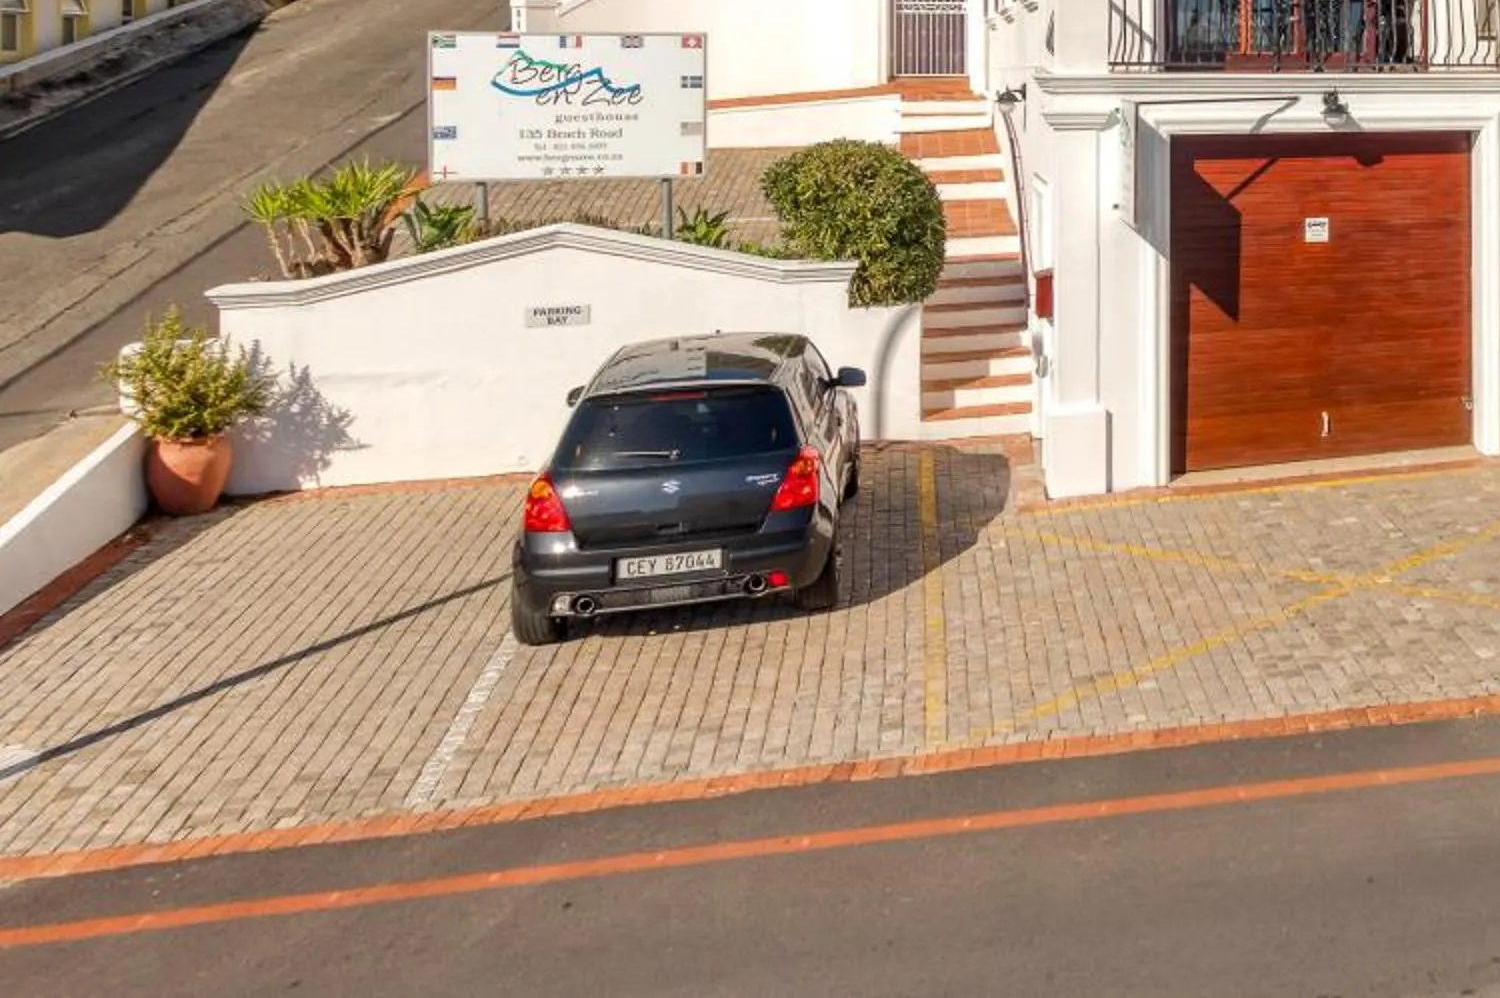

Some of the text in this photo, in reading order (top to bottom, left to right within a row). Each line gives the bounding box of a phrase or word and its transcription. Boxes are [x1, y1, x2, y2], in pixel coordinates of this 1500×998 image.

[509, 57, 583, 94] Berg
[535, 79, 645, 107] en Zee
[554, 112, 639, 124] guesthouse
[518, 128, 624, 139] 135 Beach Road
[533, 306, 581, 316] PARKING
[547, 316, 568, 325] BAY
[627, 559, 657, 575] CEY
